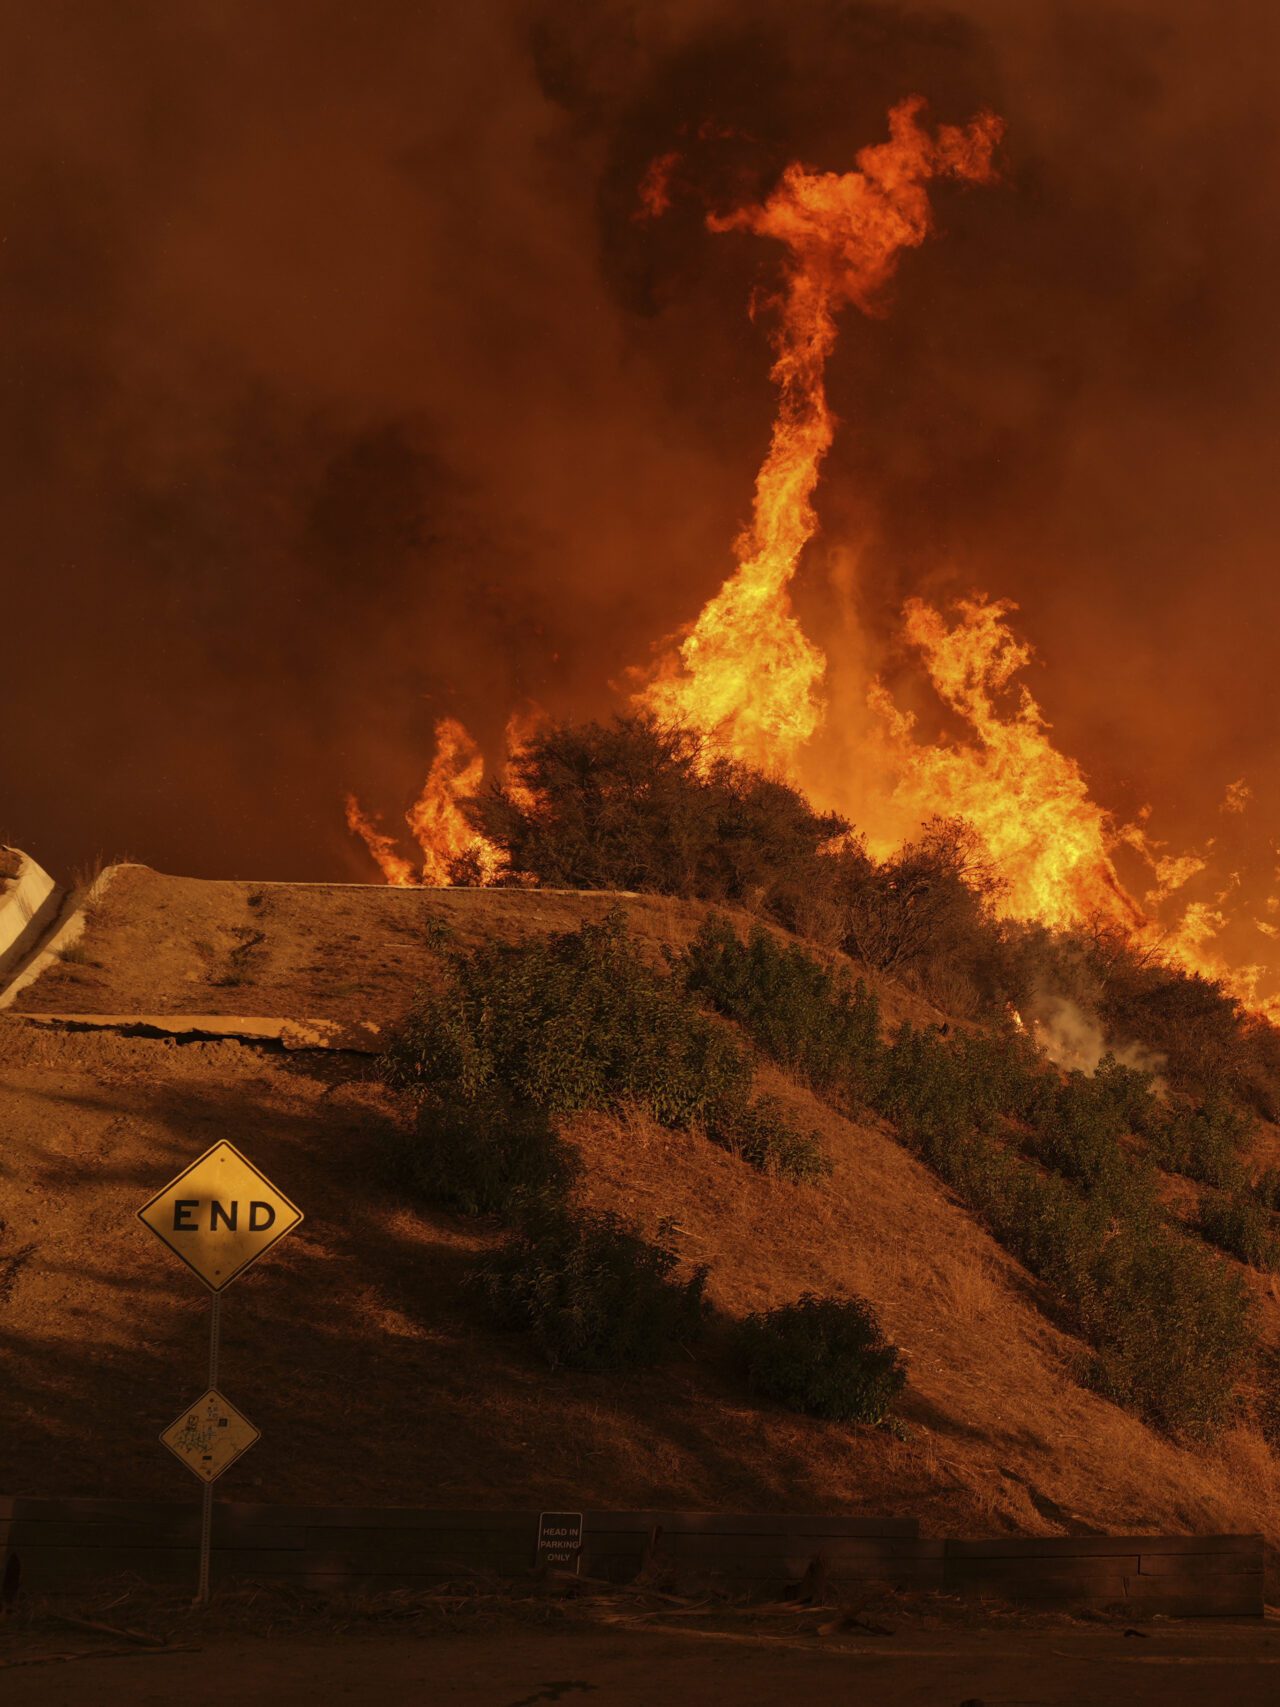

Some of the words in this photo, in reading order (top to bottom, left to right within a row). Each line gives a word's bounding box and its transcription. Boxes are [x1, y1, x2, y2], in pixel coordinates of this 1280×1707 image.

[173, 1200, 276, 1231] END
[543, 1528, 567, 1536] HEAD
[570, 1528, 578, 1536] IN
[541, 1541, 578, 1549] PARKING
[547, 1553, 570, 1561] ONLY
